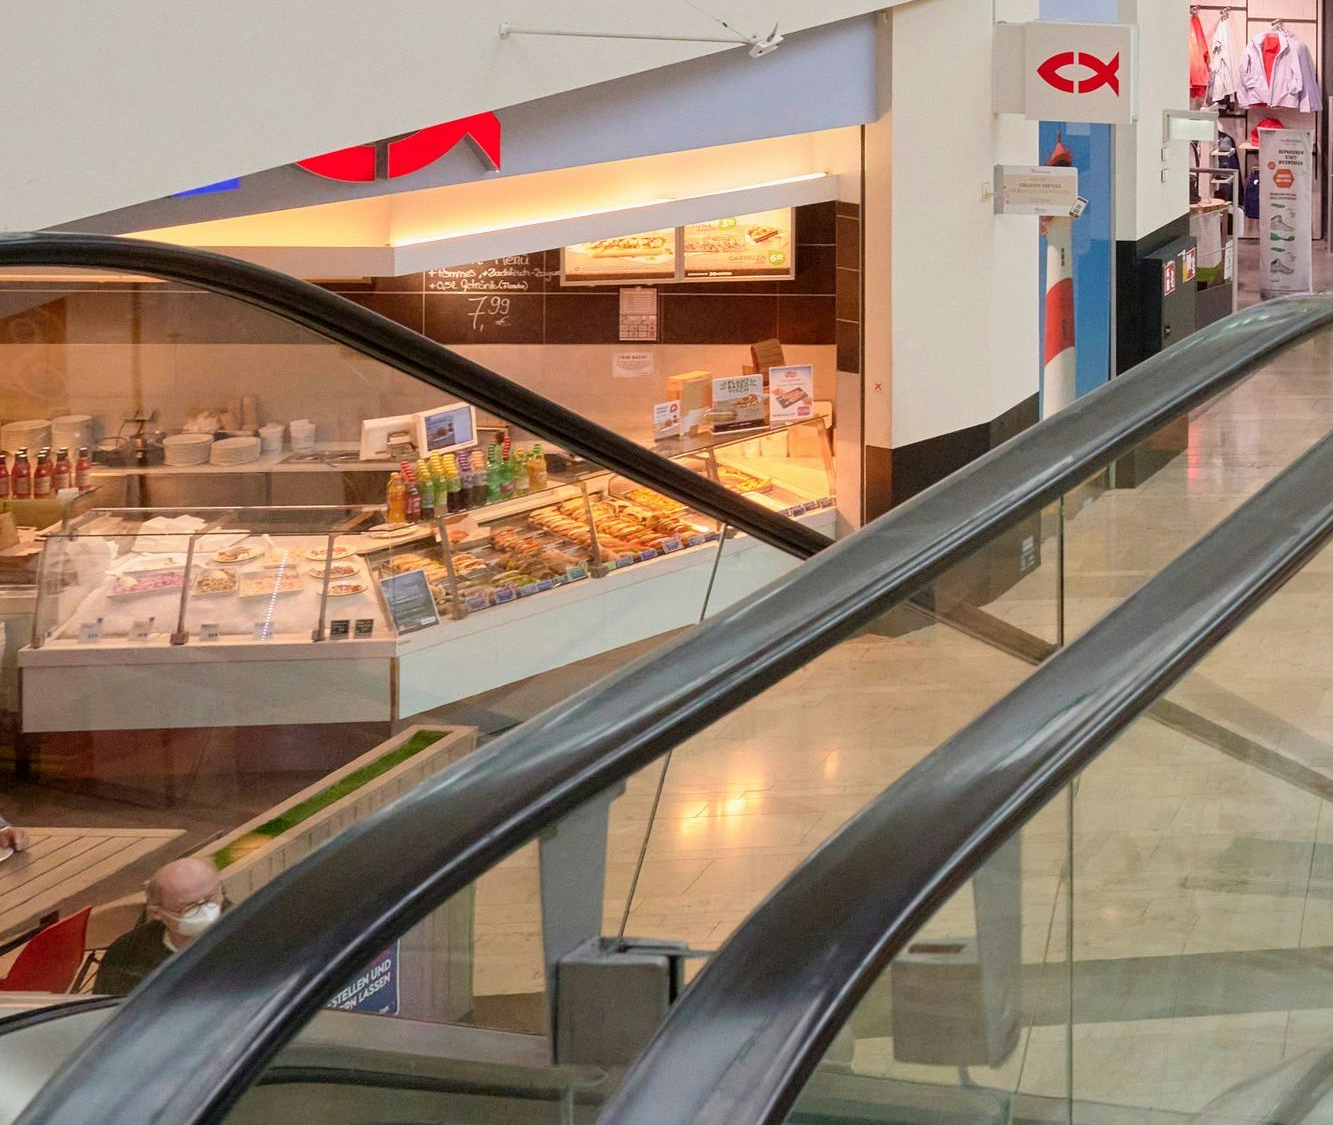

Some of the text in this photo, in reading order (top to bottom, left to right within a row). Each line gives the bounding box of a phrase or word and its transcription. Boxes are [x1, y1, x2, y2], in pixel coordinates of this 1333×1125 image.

[328, 973, 370, 1008] STELLEN
[370, 959, 392, 981] UND
[358, 971, 391, 1003] LASSEN
